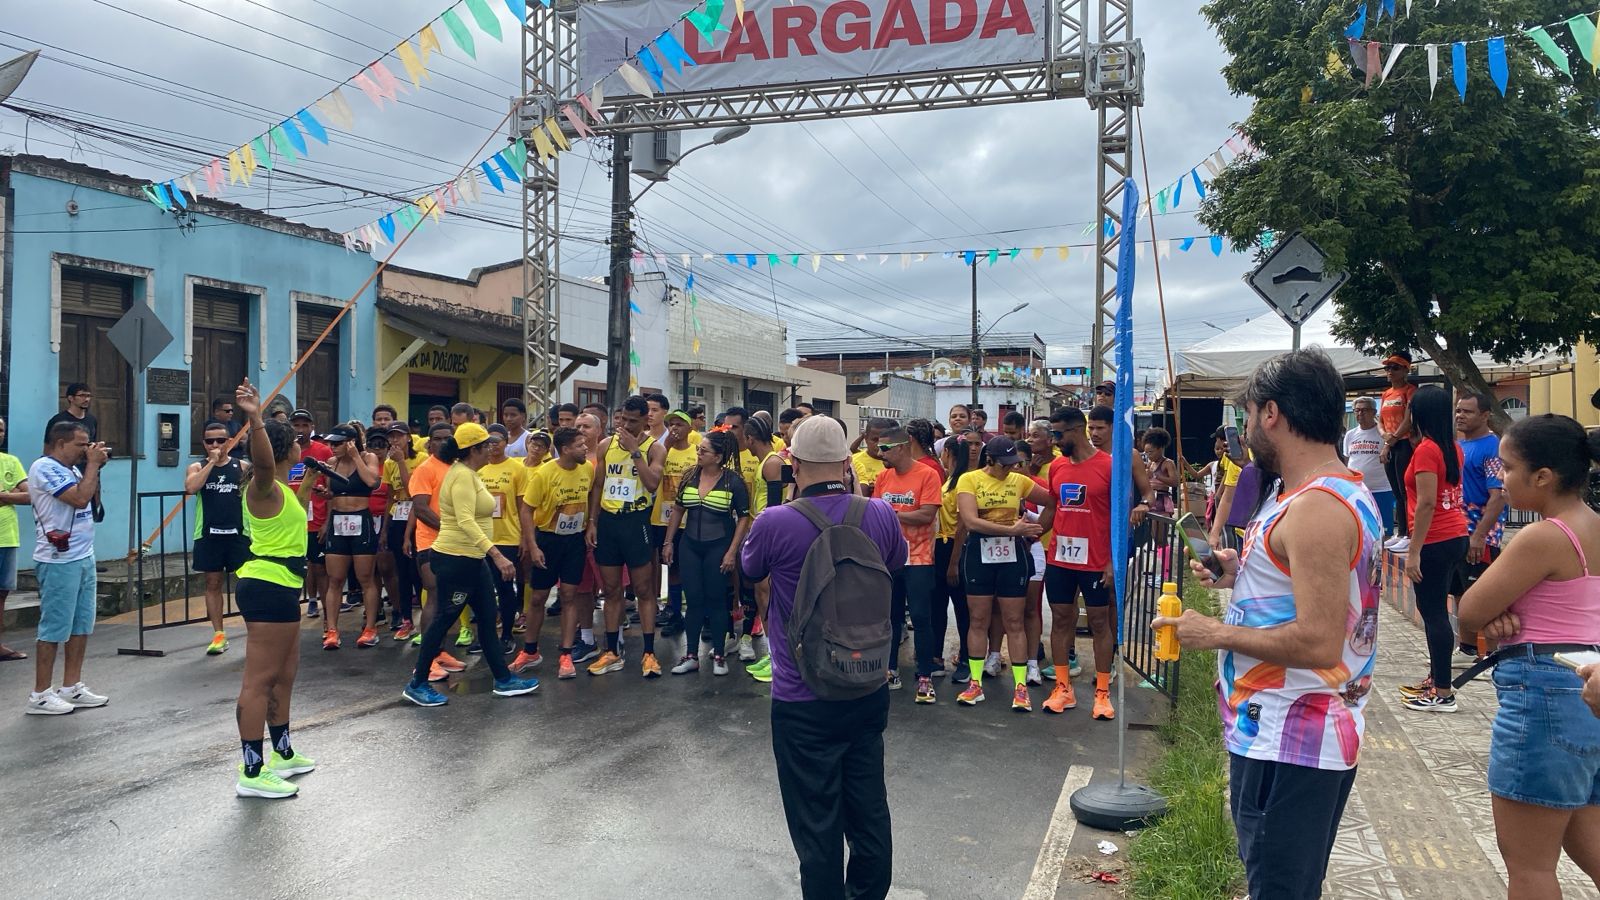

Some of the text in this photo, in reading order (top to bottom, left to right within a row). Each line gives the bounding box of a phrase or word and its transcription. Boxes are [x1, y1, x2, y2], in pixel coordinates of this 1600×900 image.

[683, 0, 1035, 66] LARGADA
[609, 485, 629, 496] 013
[338, 522, 356, 531] 116
[987, 545, 1010, 557] 135
